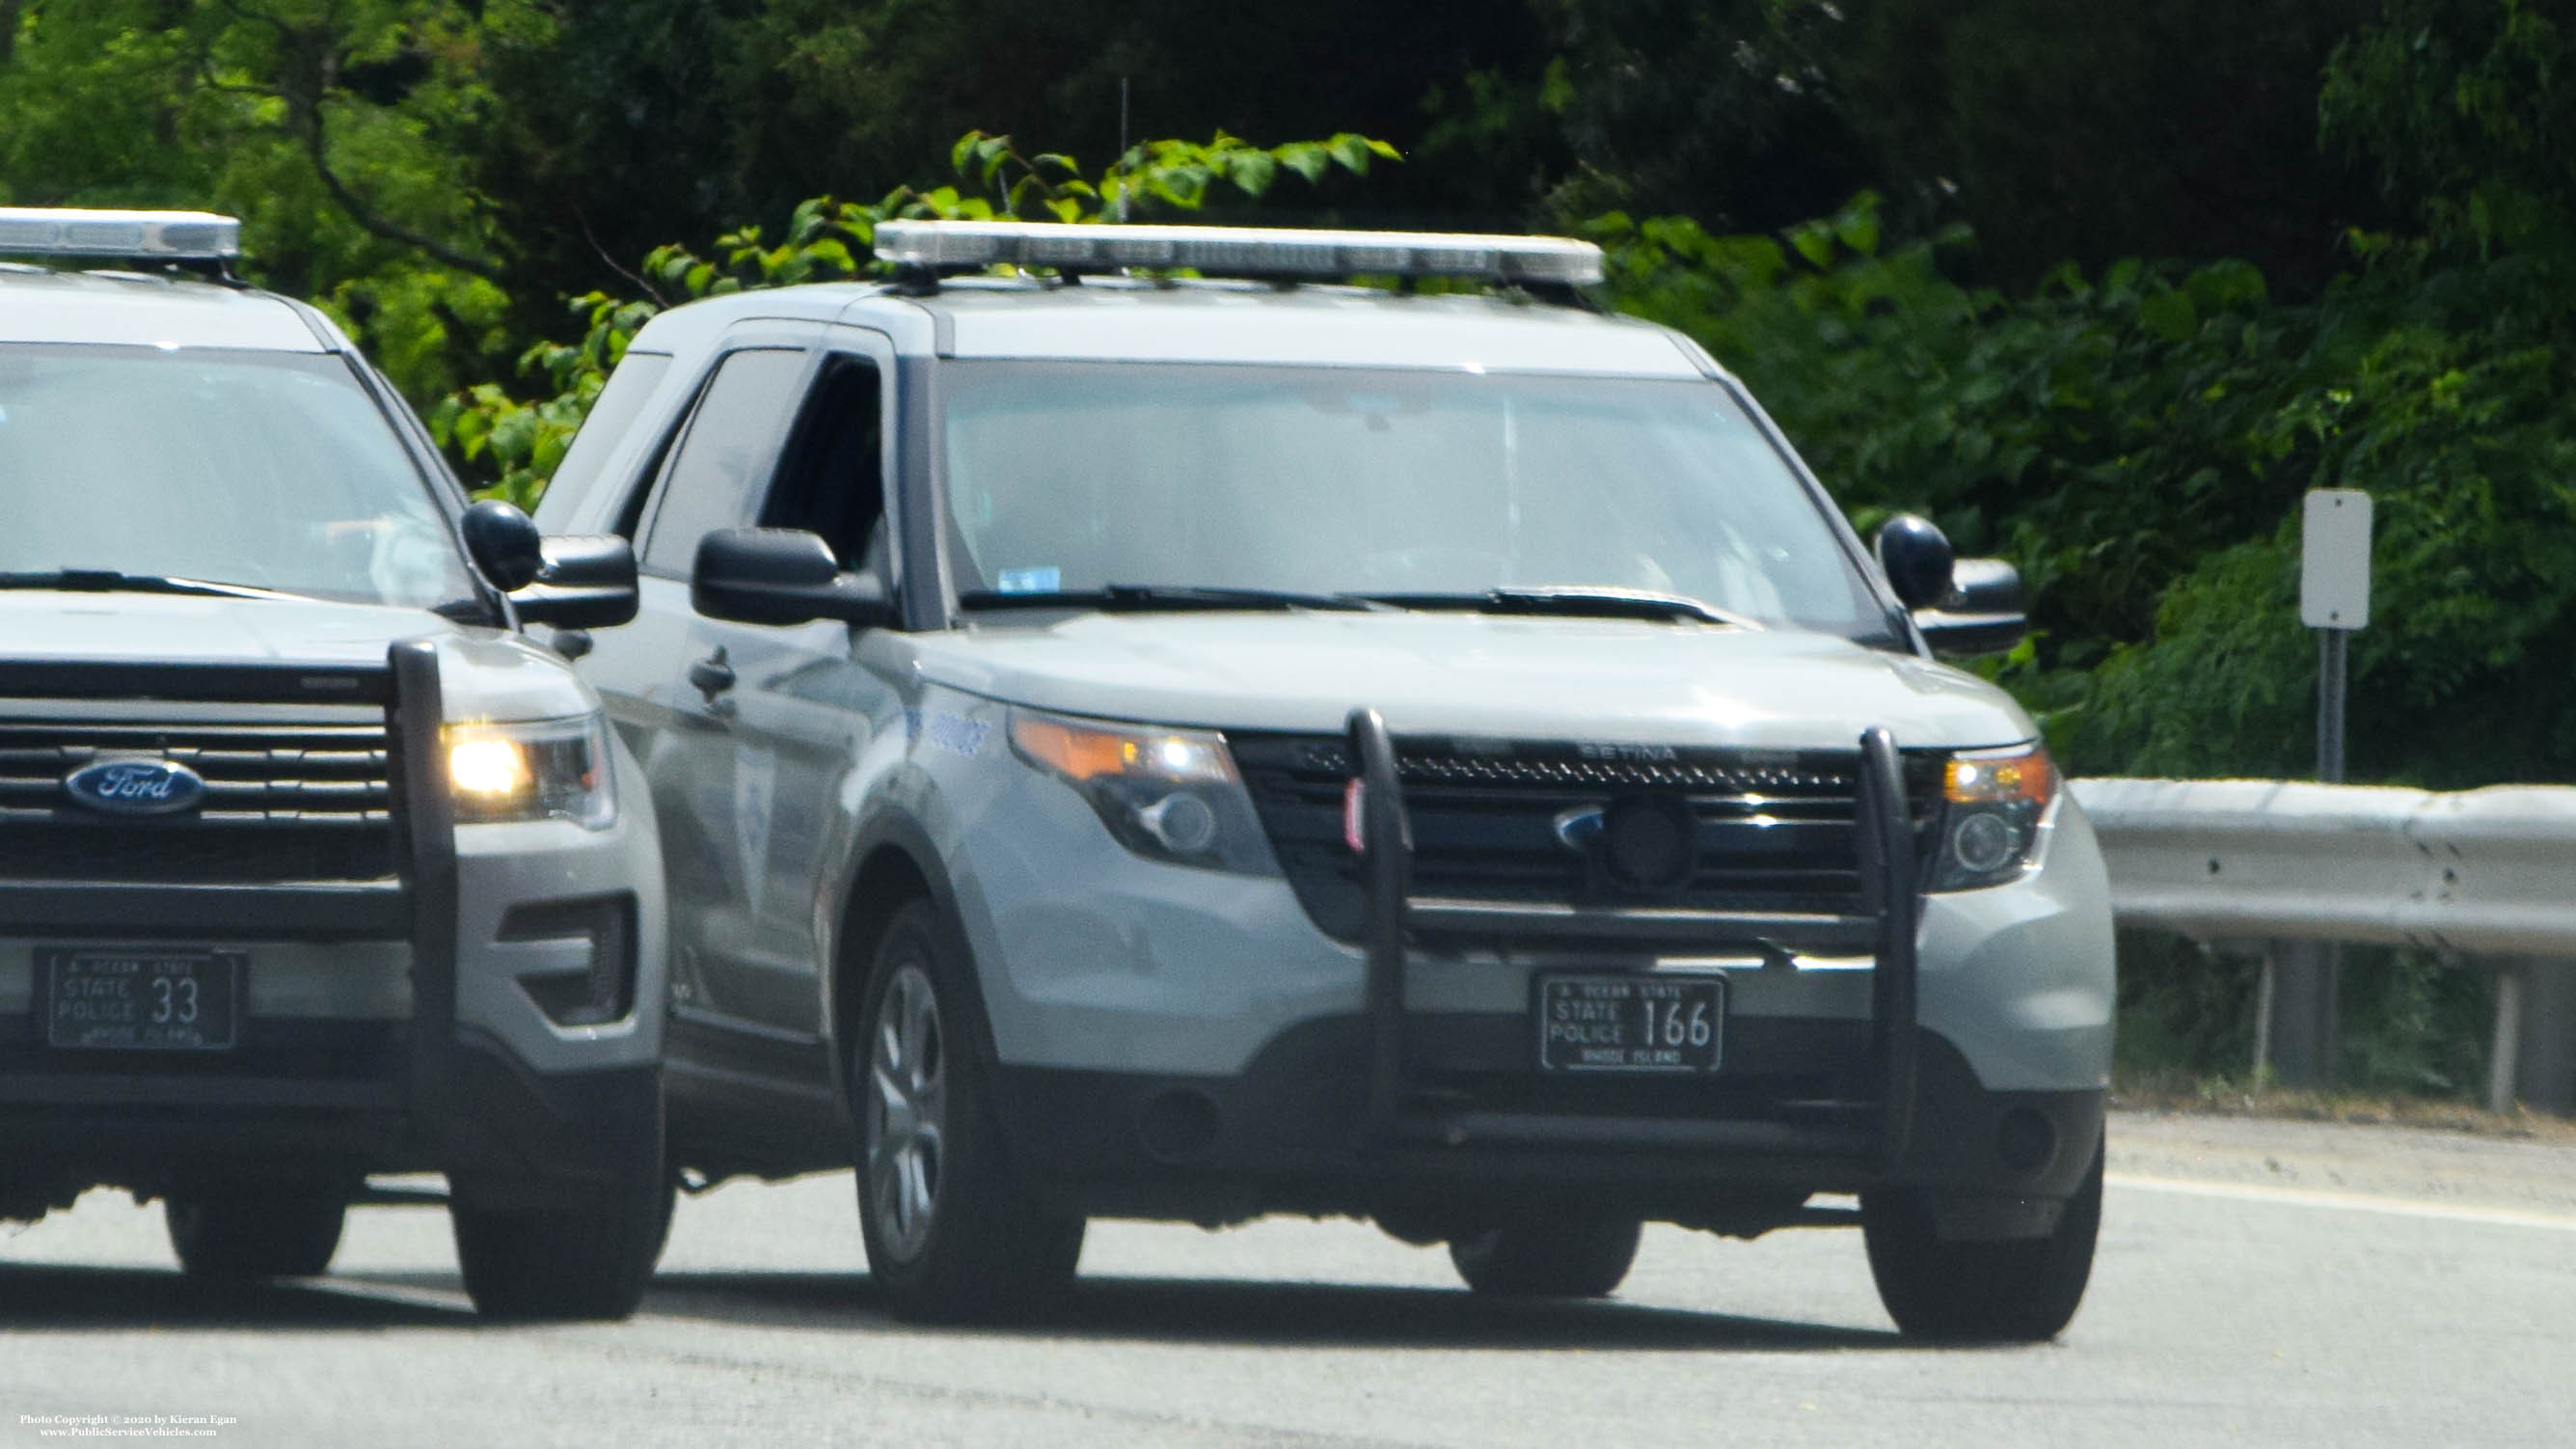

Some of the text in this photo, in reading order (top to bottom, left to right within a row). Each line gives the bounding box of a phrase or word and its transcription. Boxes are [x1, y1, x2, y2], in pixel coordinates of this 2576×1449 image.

[97, 766, 174, 798] Ford
[64, 977, 132, 998] STATE
[58, 999, 135, 1022] POLICE
[151, 976, 199, 1024] 33
[1555, 999, 1617, 1021] STATE
[1549, 1024, 1622, 1044] POLICE
[1644, 999, 1711, 1047] 166
